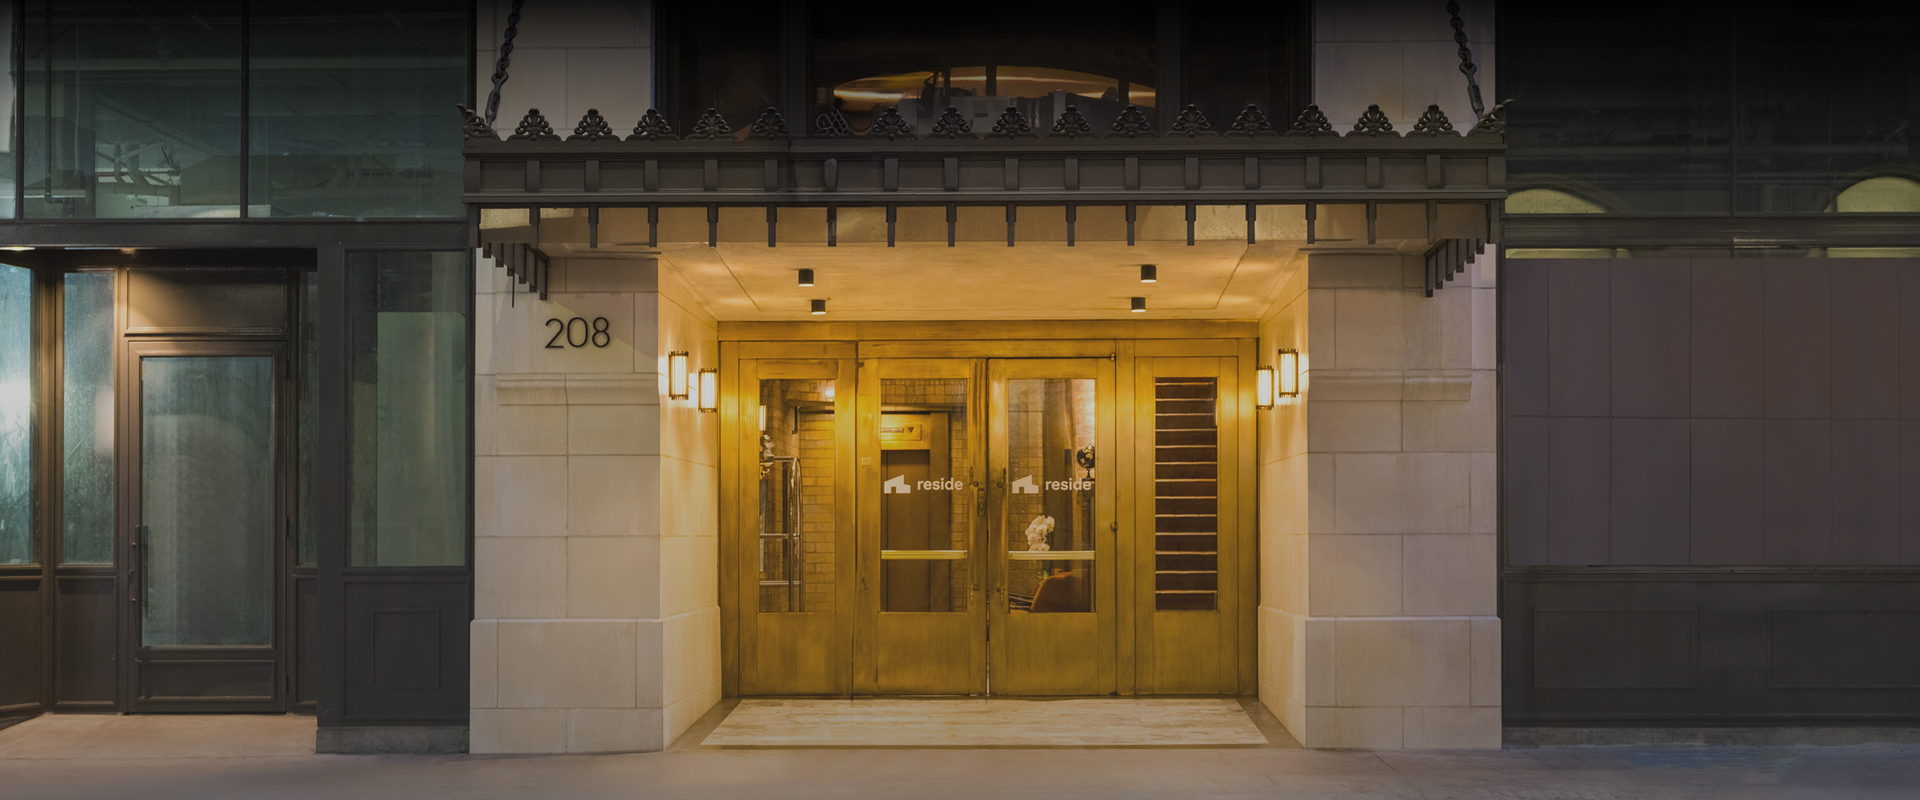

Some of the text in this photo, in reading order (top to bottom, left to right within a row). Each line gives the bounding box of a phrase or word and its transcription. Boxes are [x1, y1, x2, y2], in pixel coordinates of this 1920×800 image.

[545, 316, 610, 348] 208
[917, 477, 963, 491] reside
[1045, 477, 1092, 491] reside
